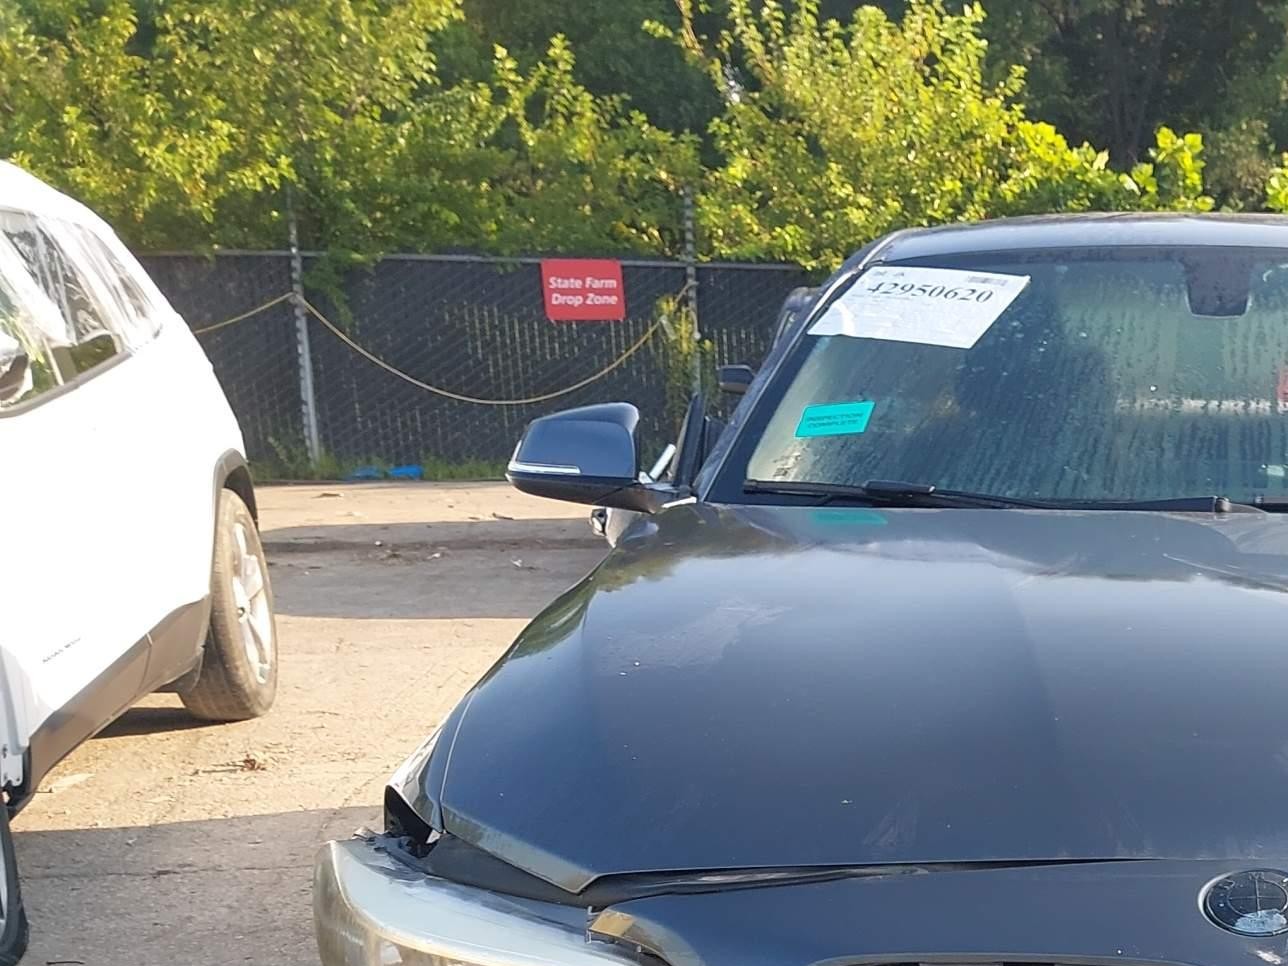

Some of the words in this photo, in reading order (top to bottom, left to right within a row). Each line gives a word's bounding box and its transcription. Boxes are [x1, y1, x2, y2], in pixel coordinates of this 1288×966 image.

[549, 276, 583, 289] State
[585, 276, 617, 289] Farm
[551, 293, 583, 308] Drop
[585, 292, 618, 305] Zone
[867, 281, 994, 304] 42950620
